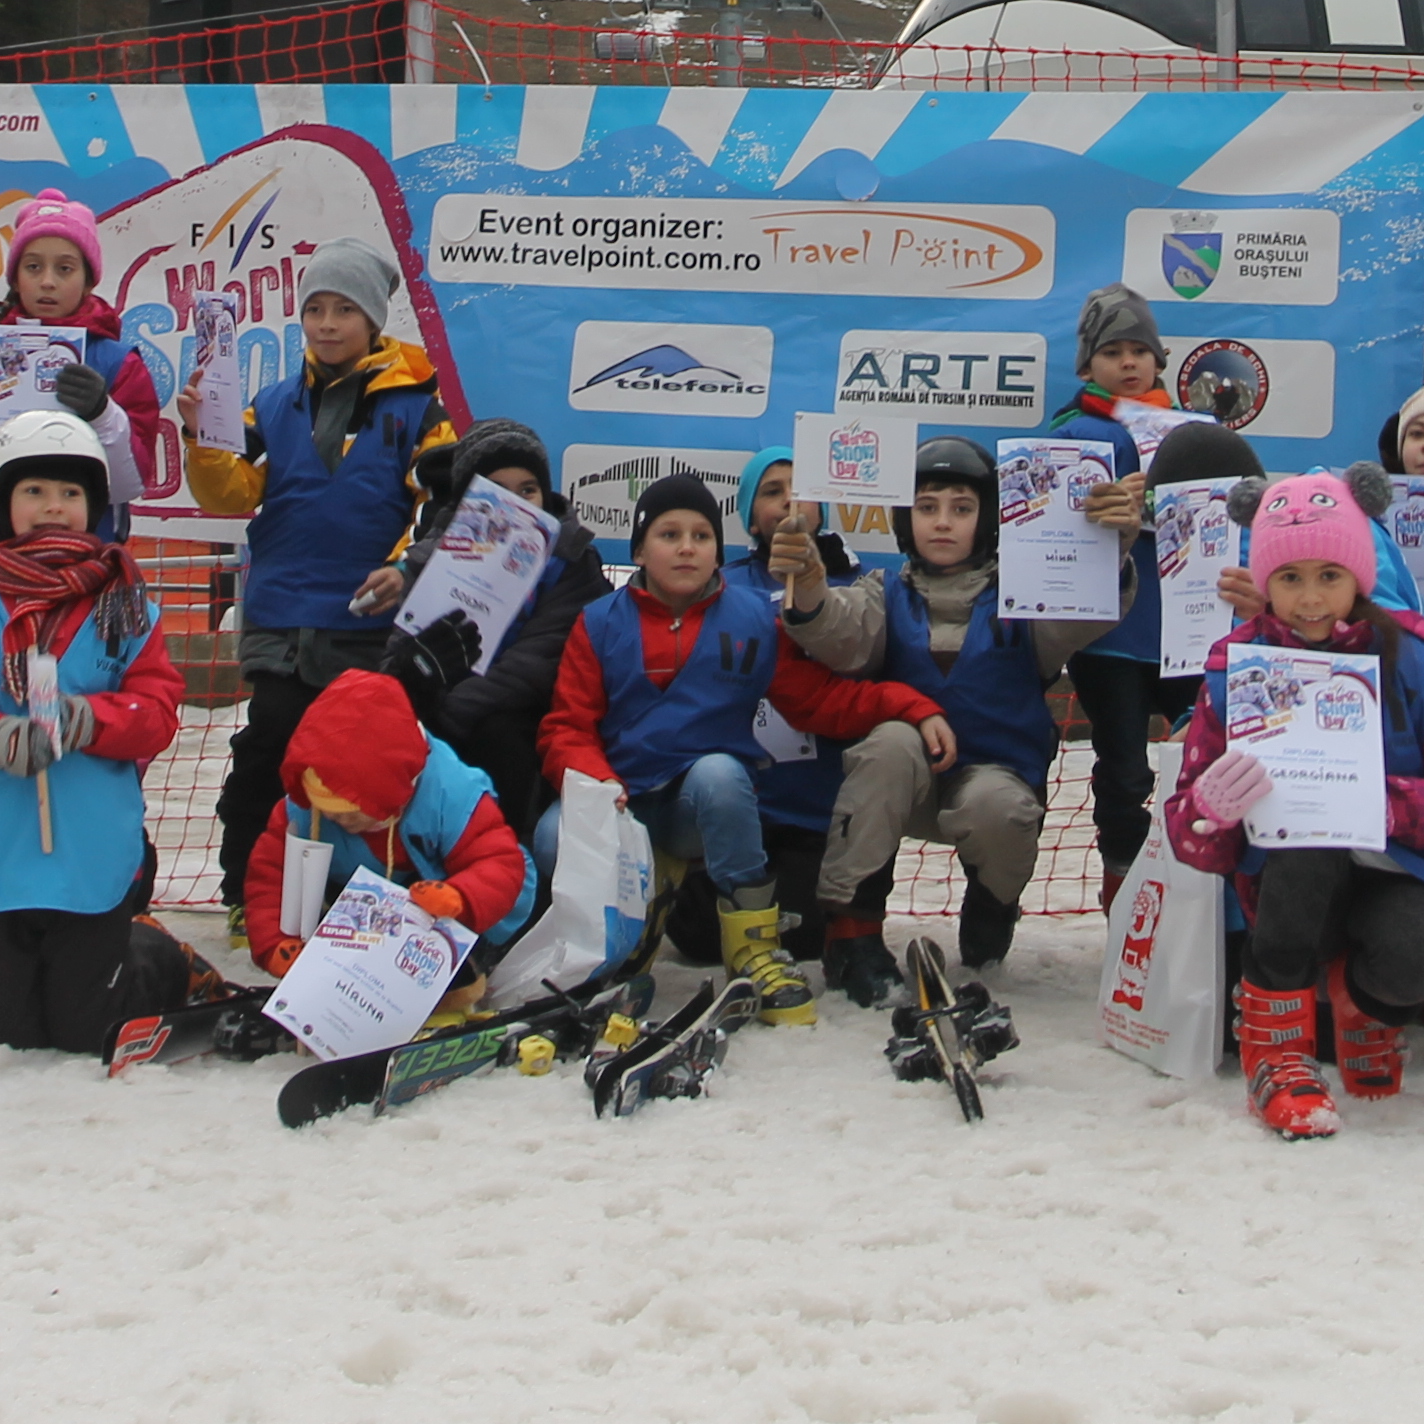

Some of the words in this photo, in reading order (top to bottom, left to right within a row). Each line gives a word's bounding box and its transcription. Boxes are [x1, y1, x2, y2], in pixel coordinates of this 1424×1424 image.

[478, 209, 564, 237] Event
[572, 213, 724, 244] organizer:
[440, 242, 762, 273] www.travelpoint.com.ro
[762, 228, 871, 264] Travel
[889, 229, 1004, 271] Point
[842, 352, 1037, 392] ARTE
[979, 394, 1035, 408] EVENIMENTE
